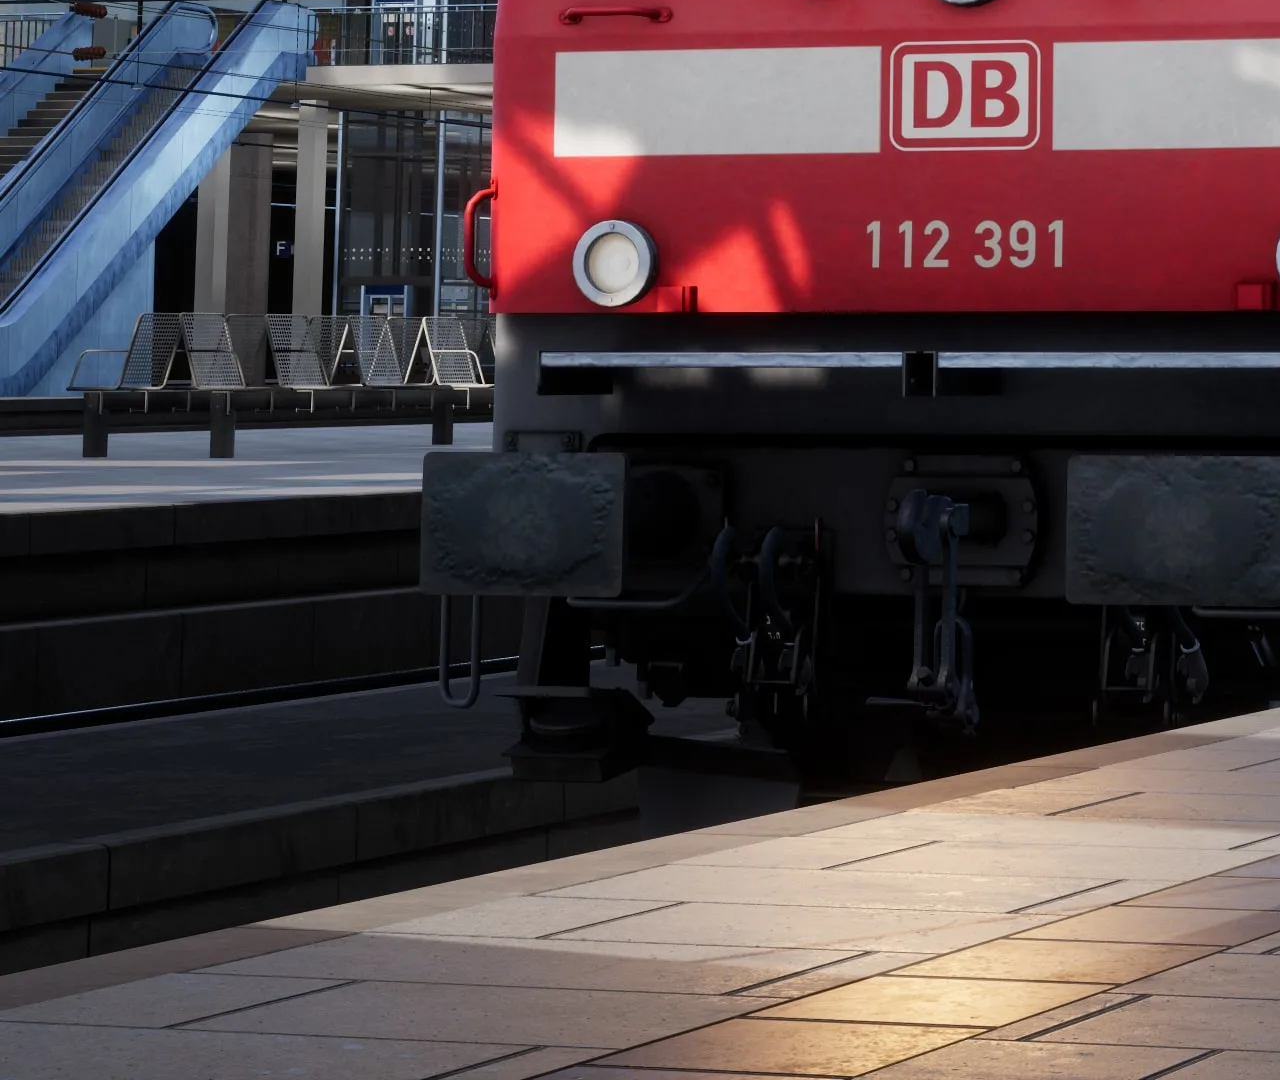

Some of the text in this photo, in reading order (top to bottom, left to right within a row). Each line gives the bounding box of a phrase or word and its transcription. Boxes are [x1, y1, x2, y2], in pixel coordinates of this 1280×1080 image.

[913, 59, 1020, 128] DB
[866, 220, 1064, 268] 112 391
